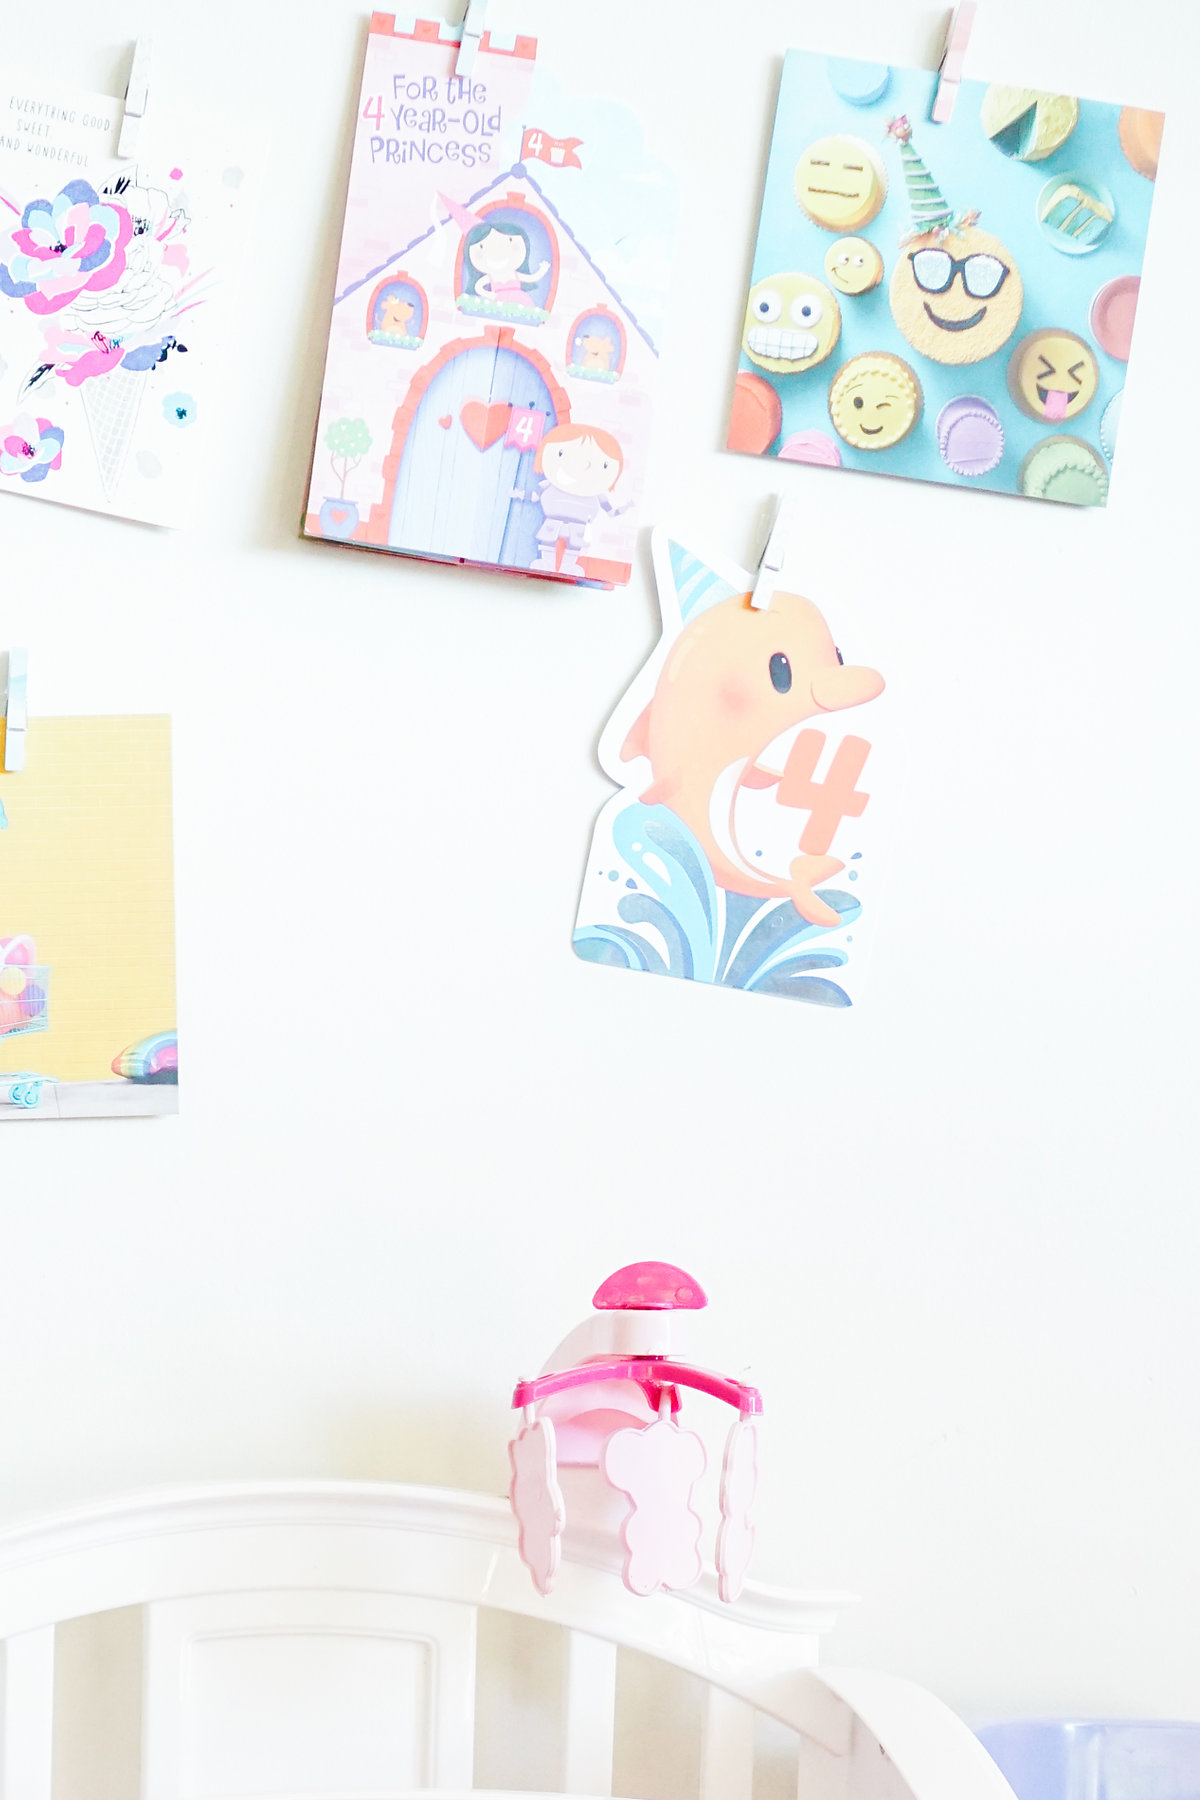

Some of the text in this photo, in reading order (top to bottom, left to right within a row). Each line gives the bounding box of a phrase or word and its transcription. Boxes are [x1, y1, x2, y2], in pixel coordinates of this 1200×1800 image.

[9, 96, 76, 123] EVERYTHING
[362, 95, 385, 131] 4
[17, 119, 50, 137] SWEET
[0, 136, 89, 167] AND WONDERFUL
[527, 132, 543, 157] 4
[515, 416, 533, 443] 4
[775, 728, 872, 856] 4
